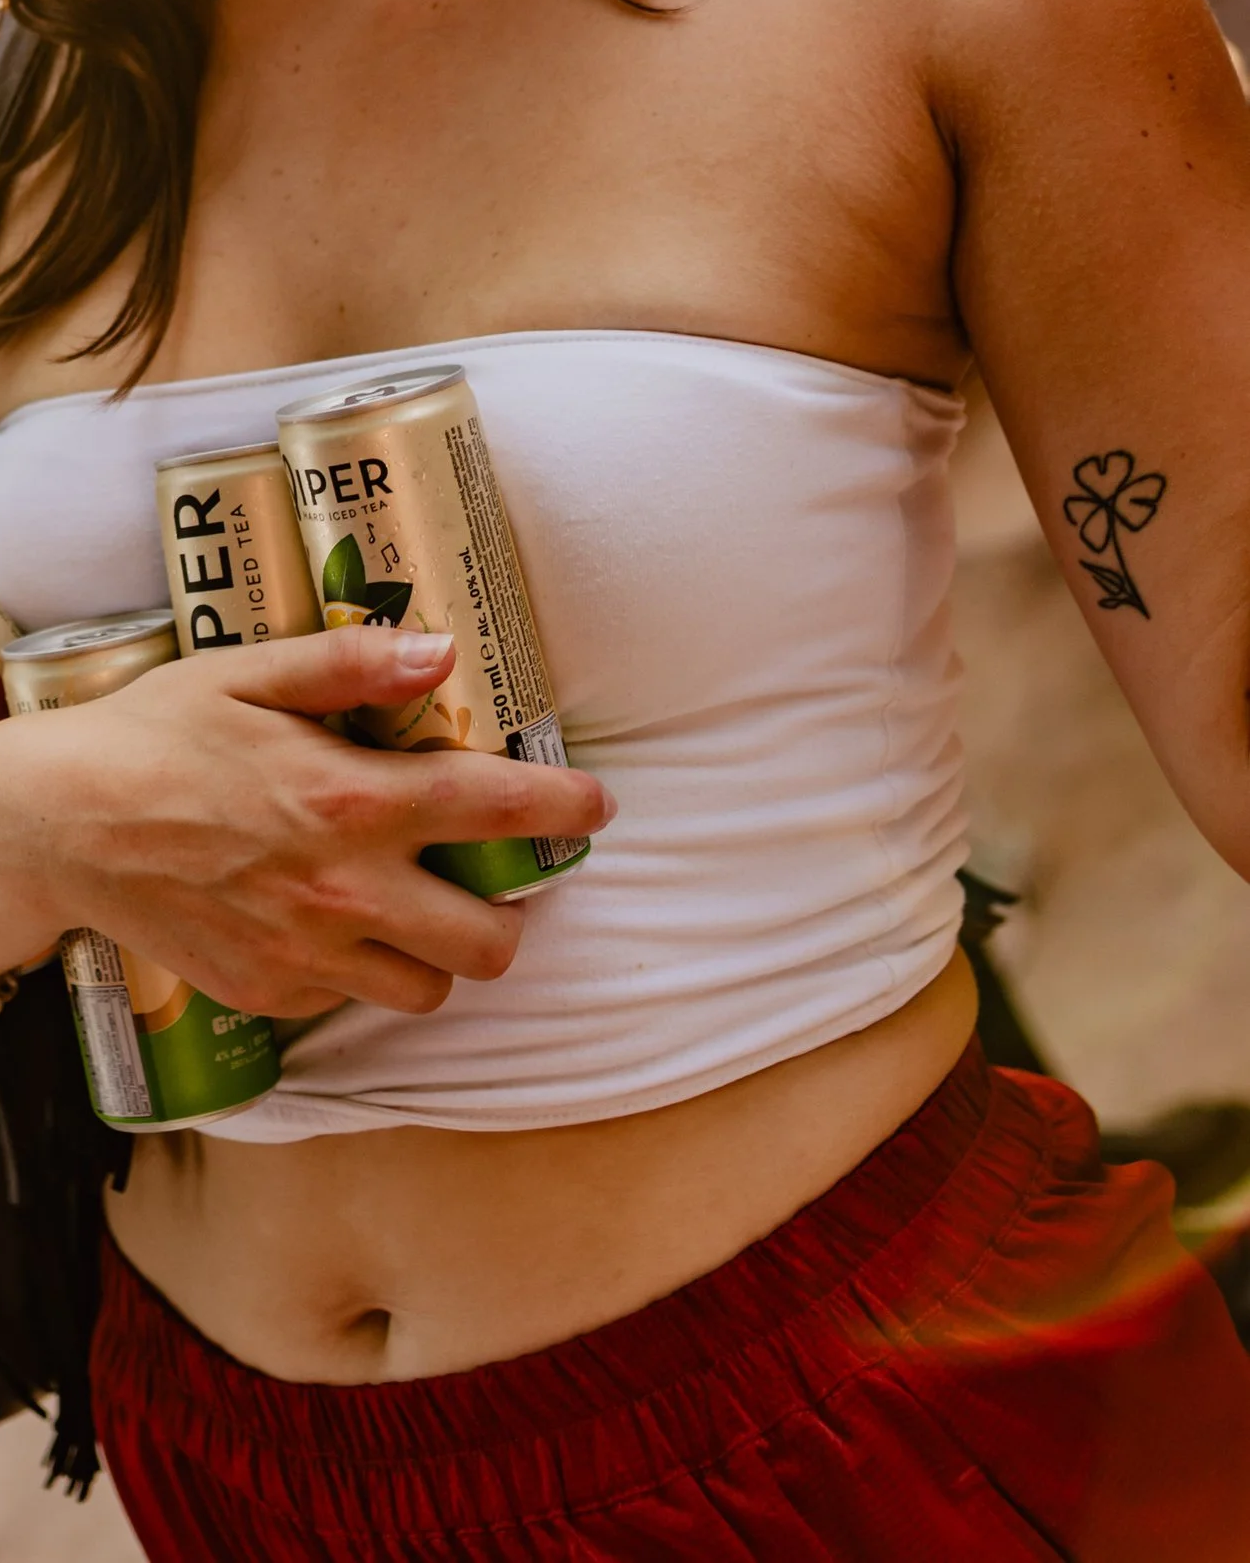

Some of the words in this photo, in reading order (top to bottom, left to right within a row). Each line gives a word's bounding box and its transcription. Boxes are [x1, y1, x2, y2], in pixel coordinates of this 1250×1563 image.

[231, 504, 253, 548] TEA
[329, 510, 357, 522] ICED
[361, 500, 388, 515] TEA
[174, 488, 243, 650] PER
[459, 547, 474, 573] vol.
[243, 557, 266, 611] ICED
[466, 575, 483, 609] 4,0%
[478, 612, 491, 637] Alc.
[484, 663, 502, 689] ml
[493, 694, 514, 731] 250
